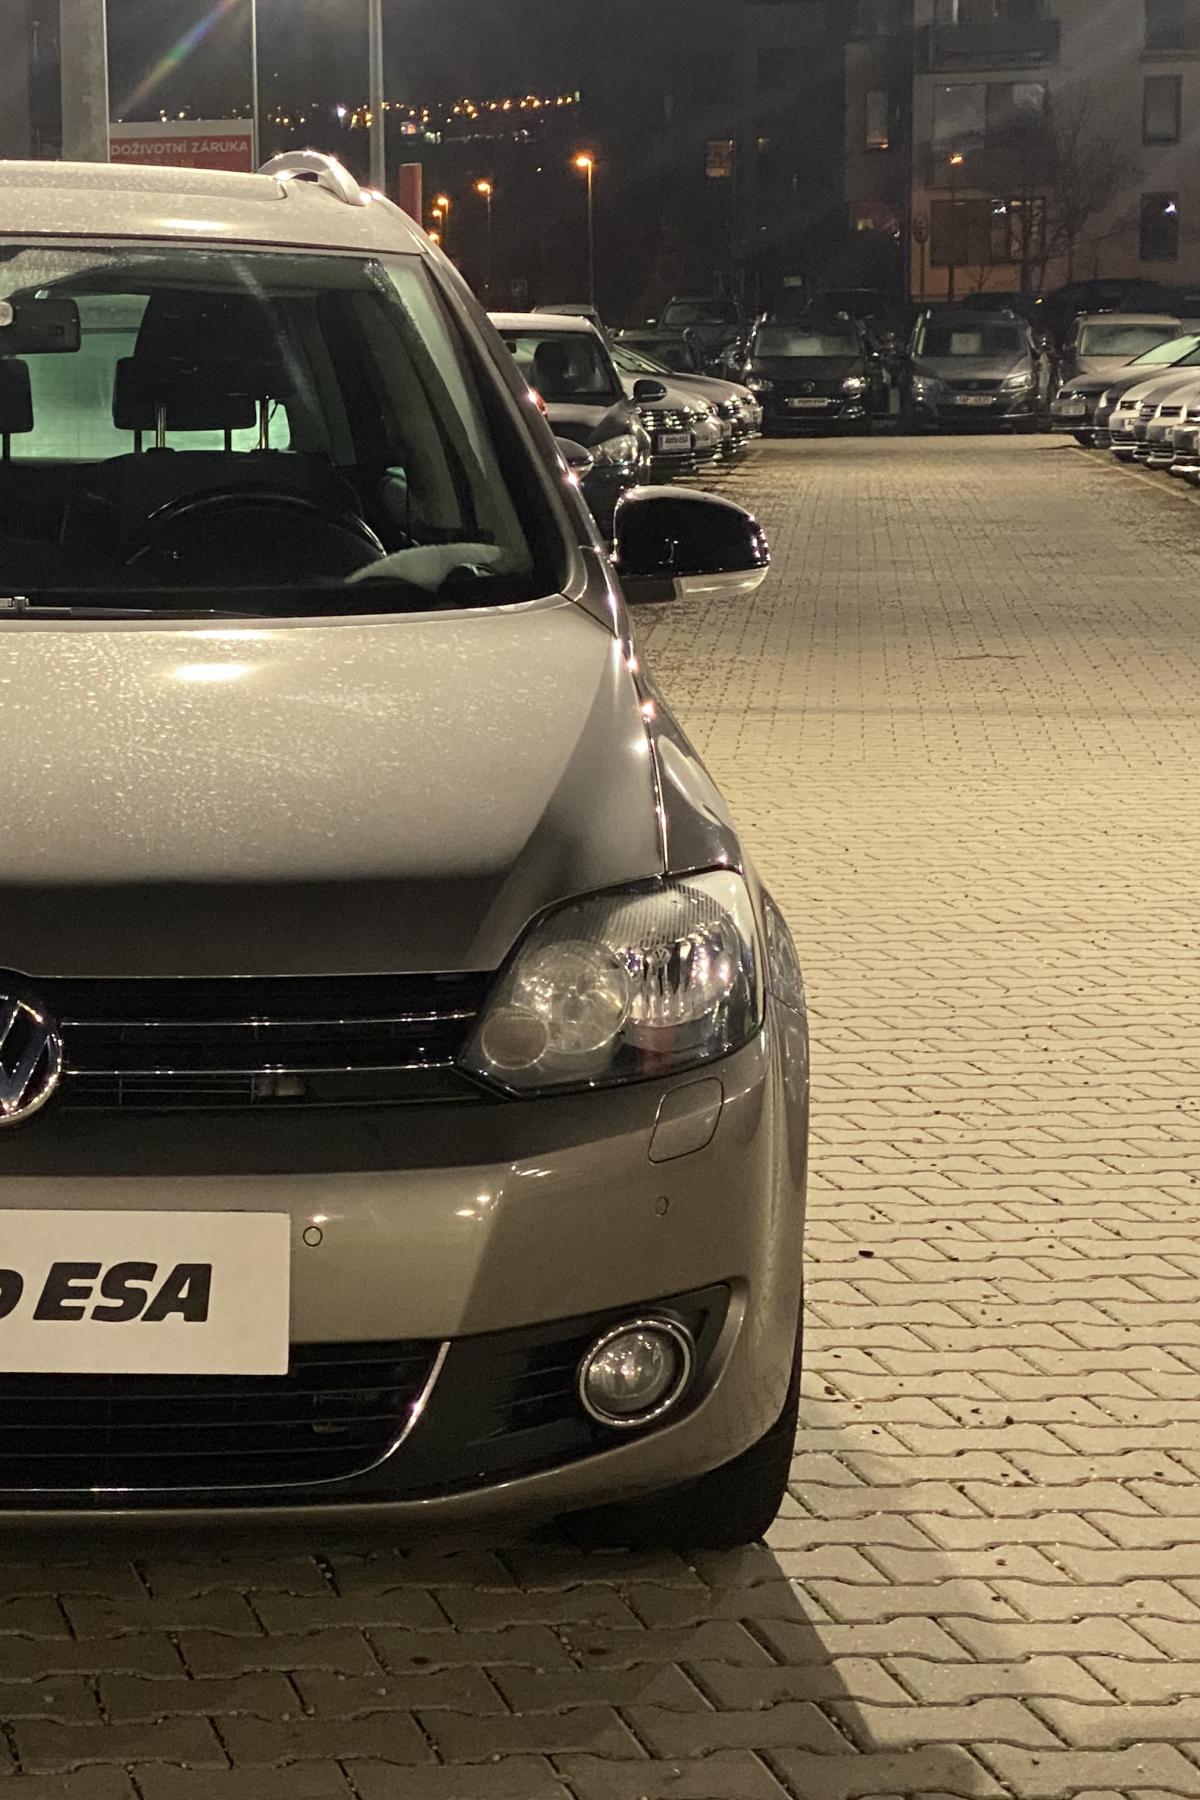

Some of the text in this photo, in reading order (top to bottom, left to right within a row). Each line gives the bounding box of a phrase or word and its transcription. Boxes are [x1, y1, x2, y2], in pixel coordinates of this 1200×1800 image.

[110, 139, 249, 156] DOŽIVOTNÍ ZÁRUKA
[32, 1261, 213, 1323] ESA
